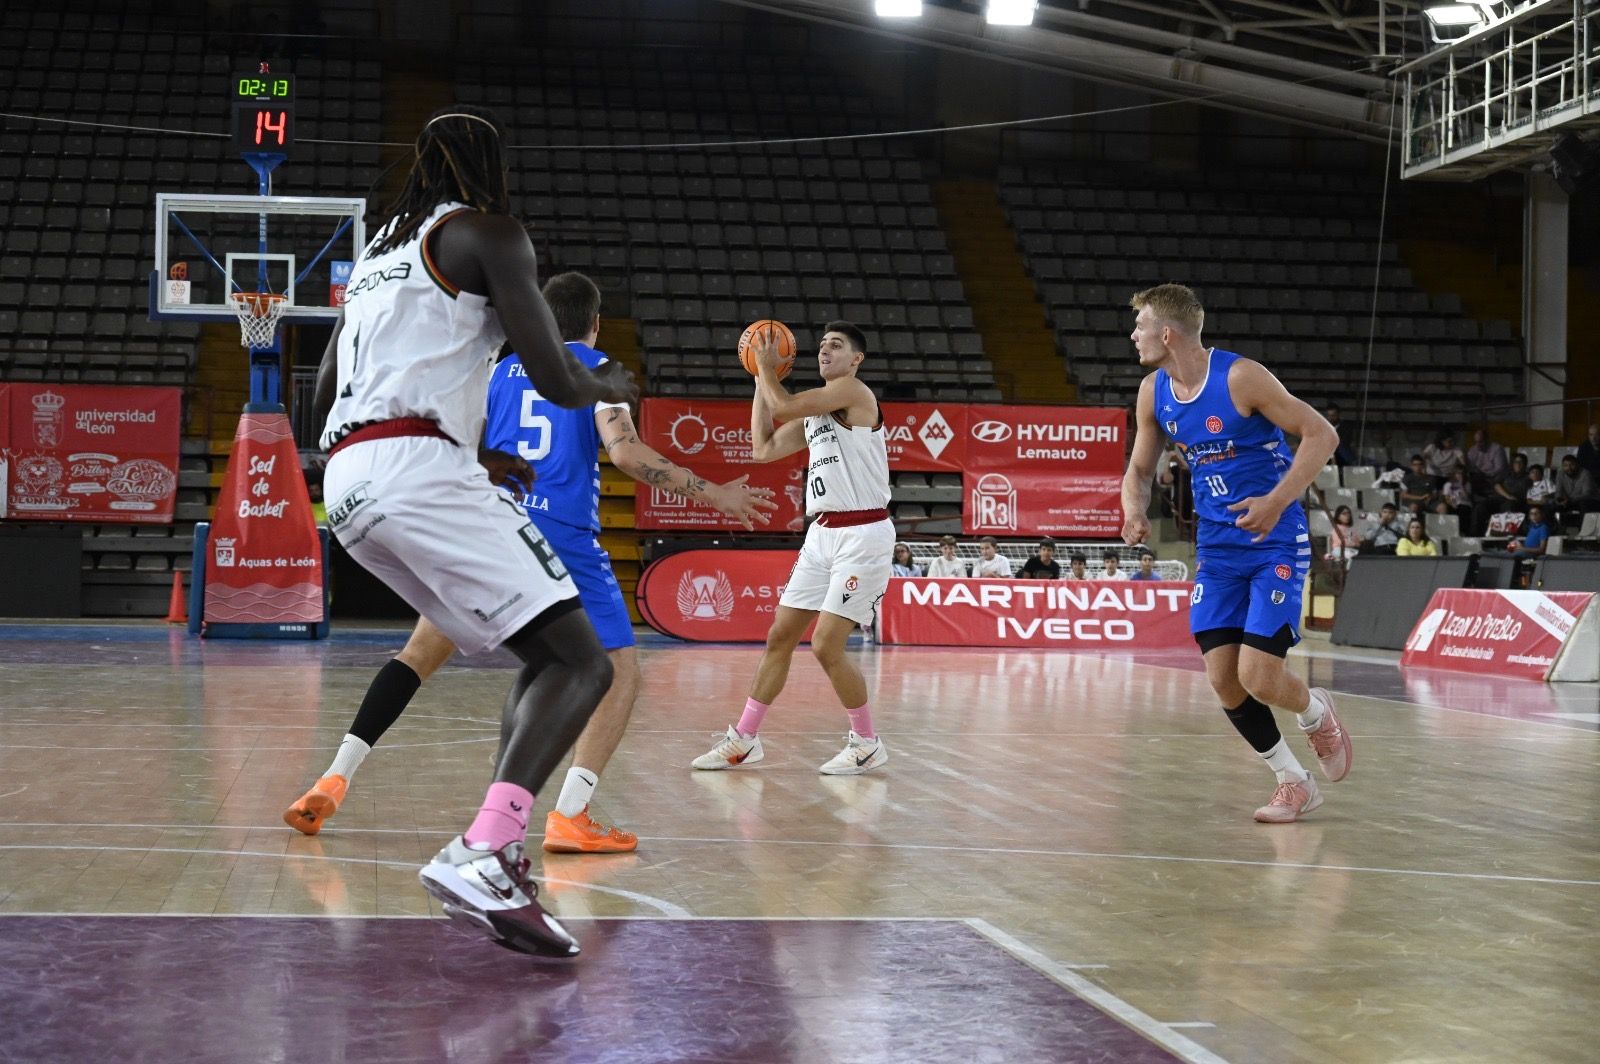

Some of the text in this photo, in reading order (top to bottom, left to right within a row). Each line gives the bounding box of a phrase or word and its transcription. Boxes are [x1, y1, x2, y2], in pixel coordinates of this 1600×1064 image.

[239, 80, 288, 96] 02:13
[255, 111, 286, 145] 14
[75, 409, 156, 423] universidad
[517, 389, 552, 461] 5
[75, 422, 115, 434] de león
[711, 426, 753, 443] Gete
[1017, 424, 1118, 442] HYUNDAI
[1017, 446, 1087, 460] Lemauto
[248, 455, 276, 475] Sed
[252, 477, 269, 497] de
[811, 476, 827, 499] 10
[1206, 474, 1229, 497] 10
[238, 499, 290, 518] Basket
[981, 496, 1009, 525] R3
[238, 557, 316, 567] Aguas de León
[902, 581, 1189, 612] MARTINAUT
[997, 617, 1135, 640] IVECO
